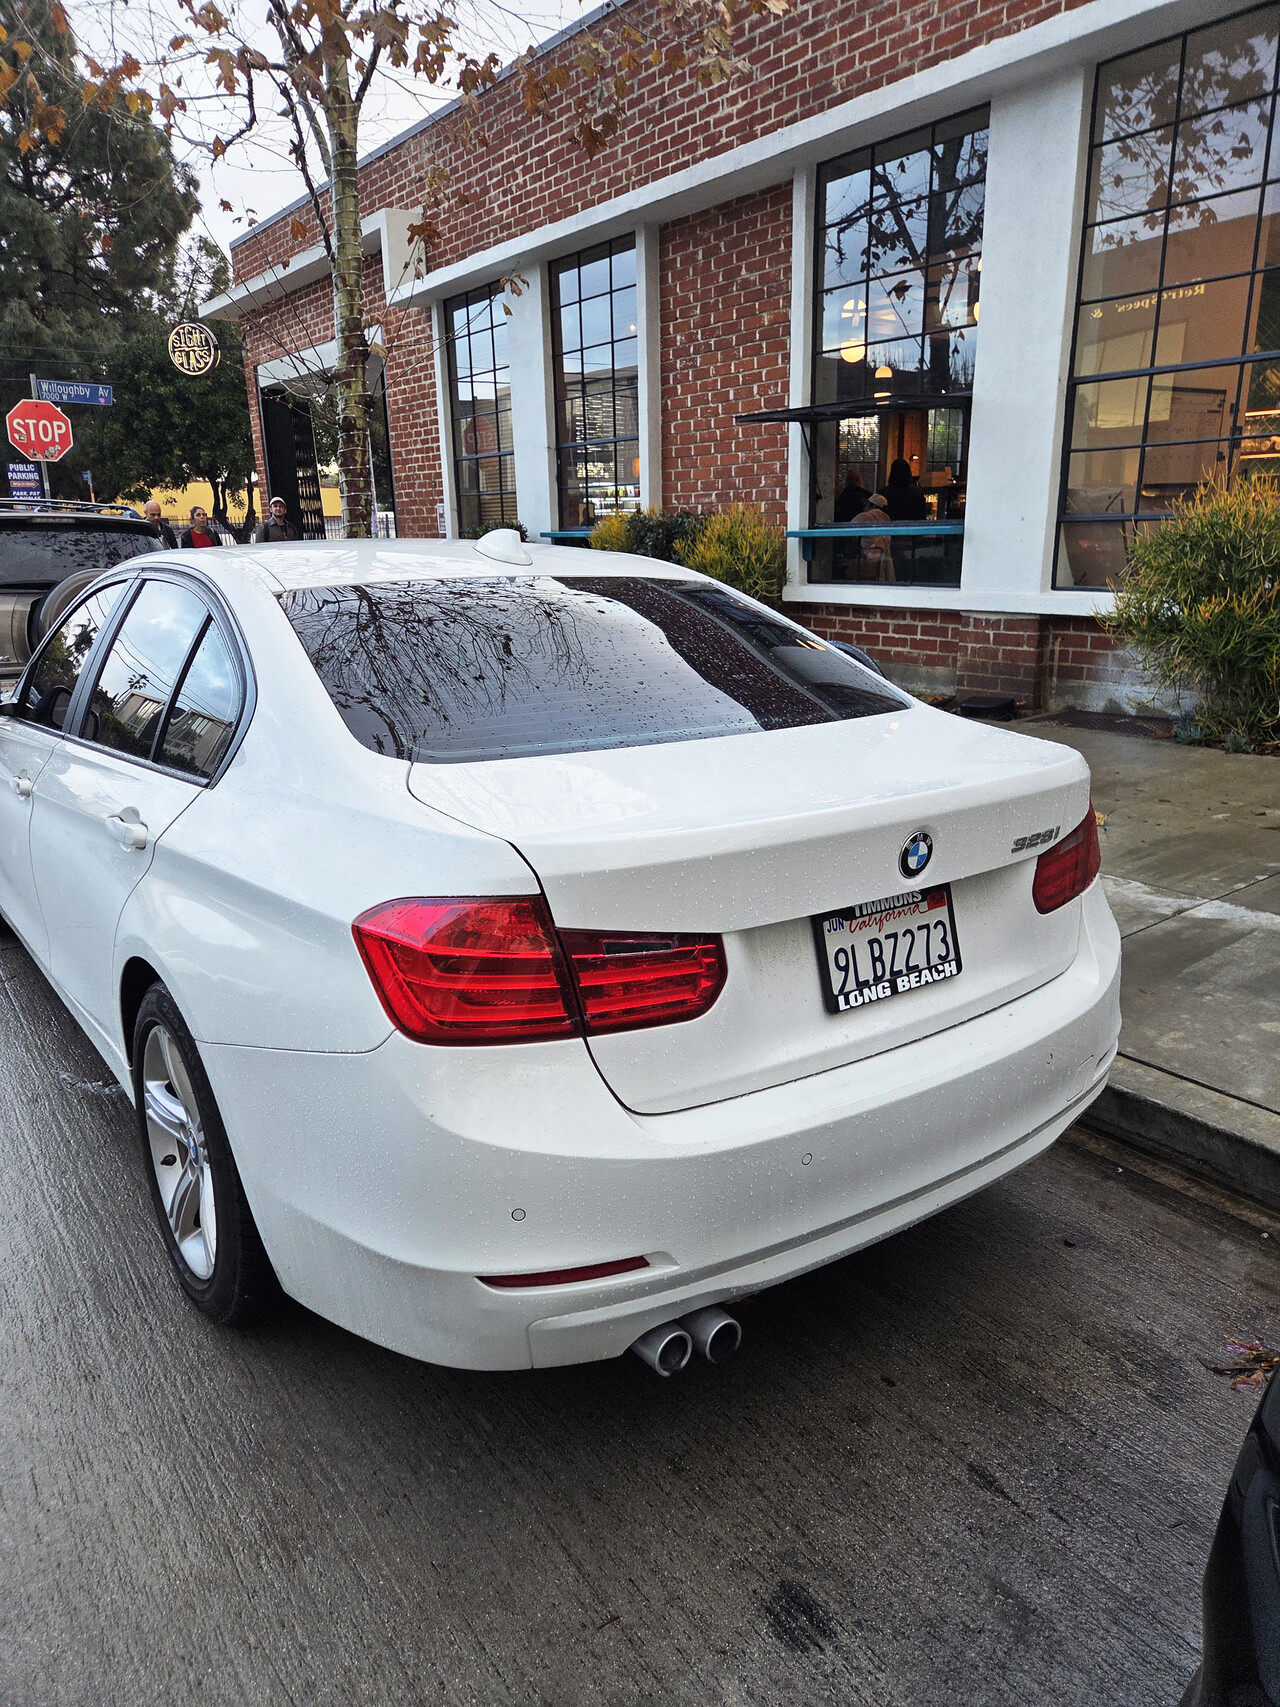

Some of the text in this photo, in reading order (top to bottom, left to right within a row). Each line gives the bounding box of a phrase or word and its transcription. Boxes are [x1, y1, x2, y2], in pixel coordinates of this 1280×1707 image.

[172, 326, 206, 347] SIGHT
[174, 350, 210, 371] GLASS
[40, 381, 109, 399] Willoughby Av
[41, 391, 68, 401] 7000 W
[12, 418, 67, 443] STOP
[7, 471, 40, 480] PARKING
[9, 463, 35, 471] PUBLIC
[905, 833, 932, 850] BMW
[852, 890, 922, 917] TIMMONS
[827, 917, 845, 933] JUN
[848, 903, 929, 934] California
[833, 919, 951, 995] 9LBZ273
[838, 960, 958, 1011] LONG BEACH
